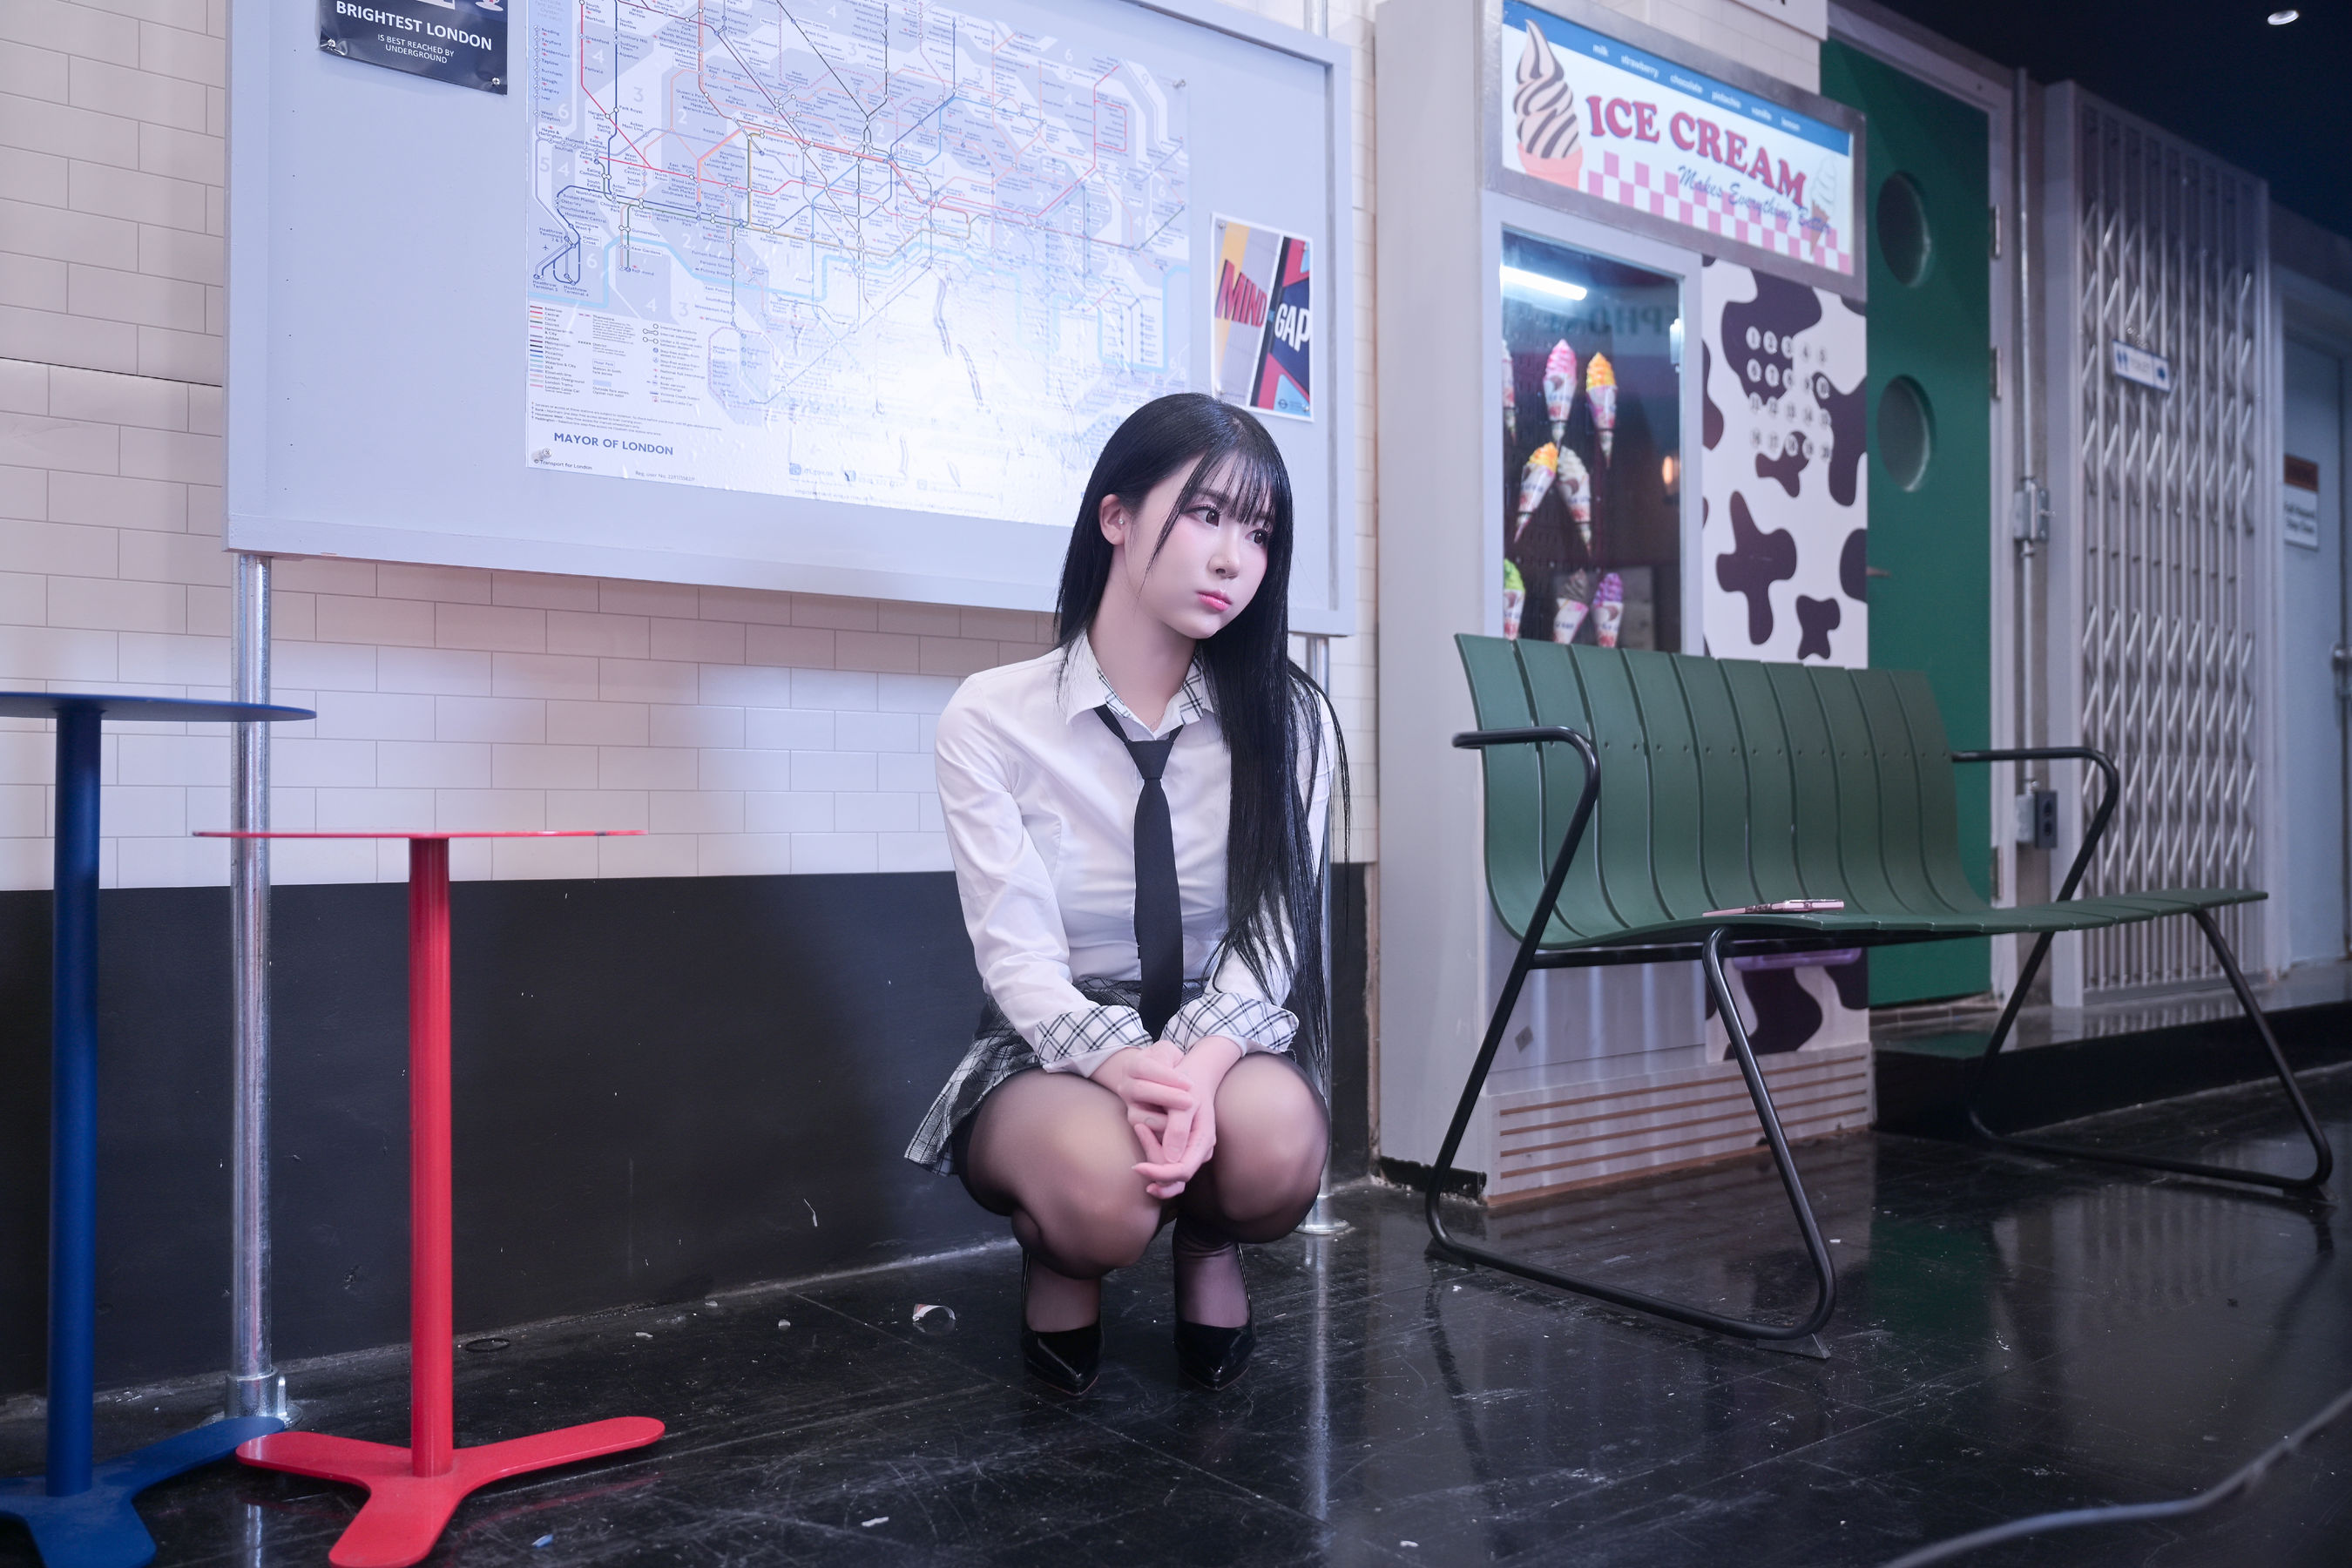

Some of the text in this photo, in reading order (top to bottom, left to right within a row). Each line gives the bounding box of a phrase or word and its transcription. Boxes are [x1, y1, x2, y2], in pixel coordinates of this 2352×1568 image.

[336, 0, 492, 51] BRIGHTEST LONDON
[385, 44, 448, 64] UNDERGROUND
[387, 36, 405, 46] BEST
[407, 40, 443, 55] REACHED
[445, 49, 455, 57] BY
[1064, 49, 1073, 62] 6
[1593, 44, 1608, 57] milk
[1621, 55, 1659, 78] strawberry
[1670, 75, 1703, 94] chocolate
[1751, 106, 1772, 121] vanilla
[633, 86, 645, 103] 3
[558, 103, 570, 119] 6
[677, 109, 688, 125] 2
[1585, 95, 1807, 208] ICE CREAM
[558, 161, 571, 177] 4
[1678, 166, 1723, 198] Makes
[1728, 182, 1792, 228] Everything
[585, 253, 598, 269] 6
[646, 298, 658, 313] 4
[1214, 259, 1310, 353] MIND GAP
[554, 432, 673, 456] MAYOR OF LONDON
[540, 459, 564, 469] Transport
